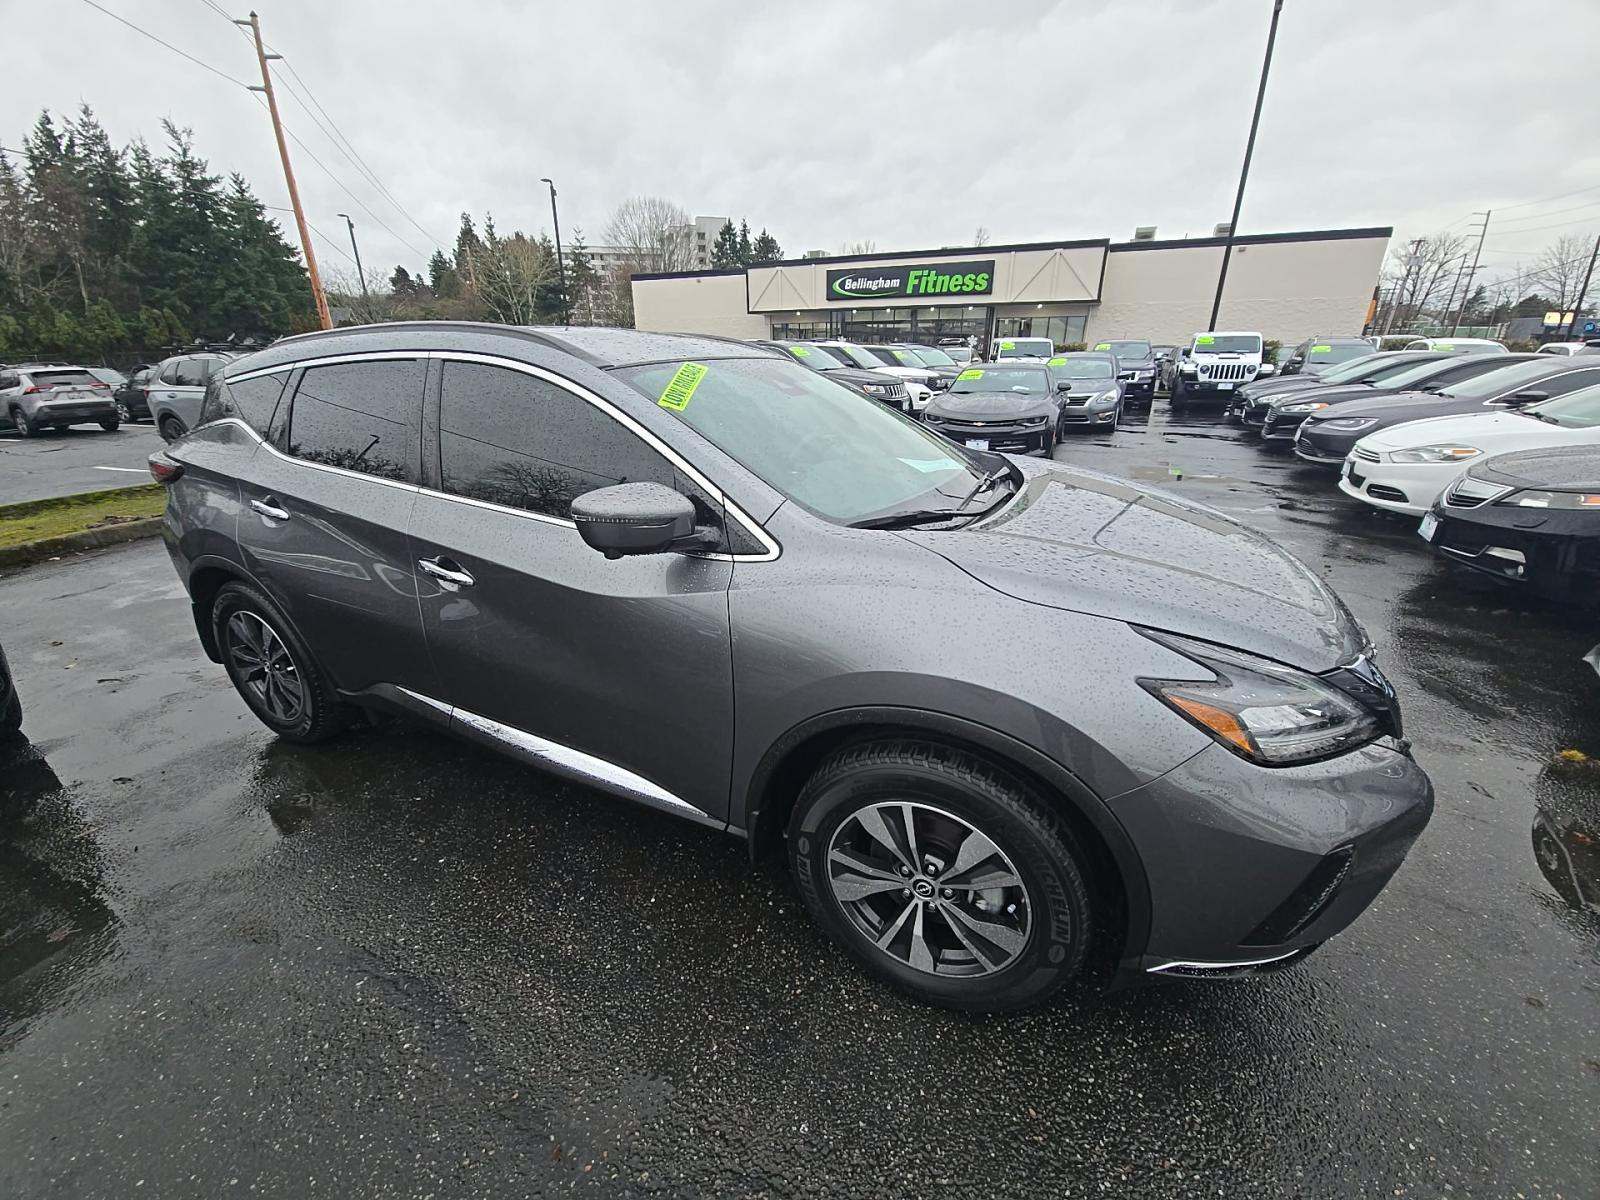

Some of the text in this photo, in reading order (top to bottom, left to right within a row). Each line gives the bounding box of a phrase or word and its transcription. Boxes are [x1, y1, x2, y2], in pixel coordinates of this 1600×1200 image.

[845, 270, 989, 294] Bellingham Fitness
[661, 387, 687, 406] LOW
